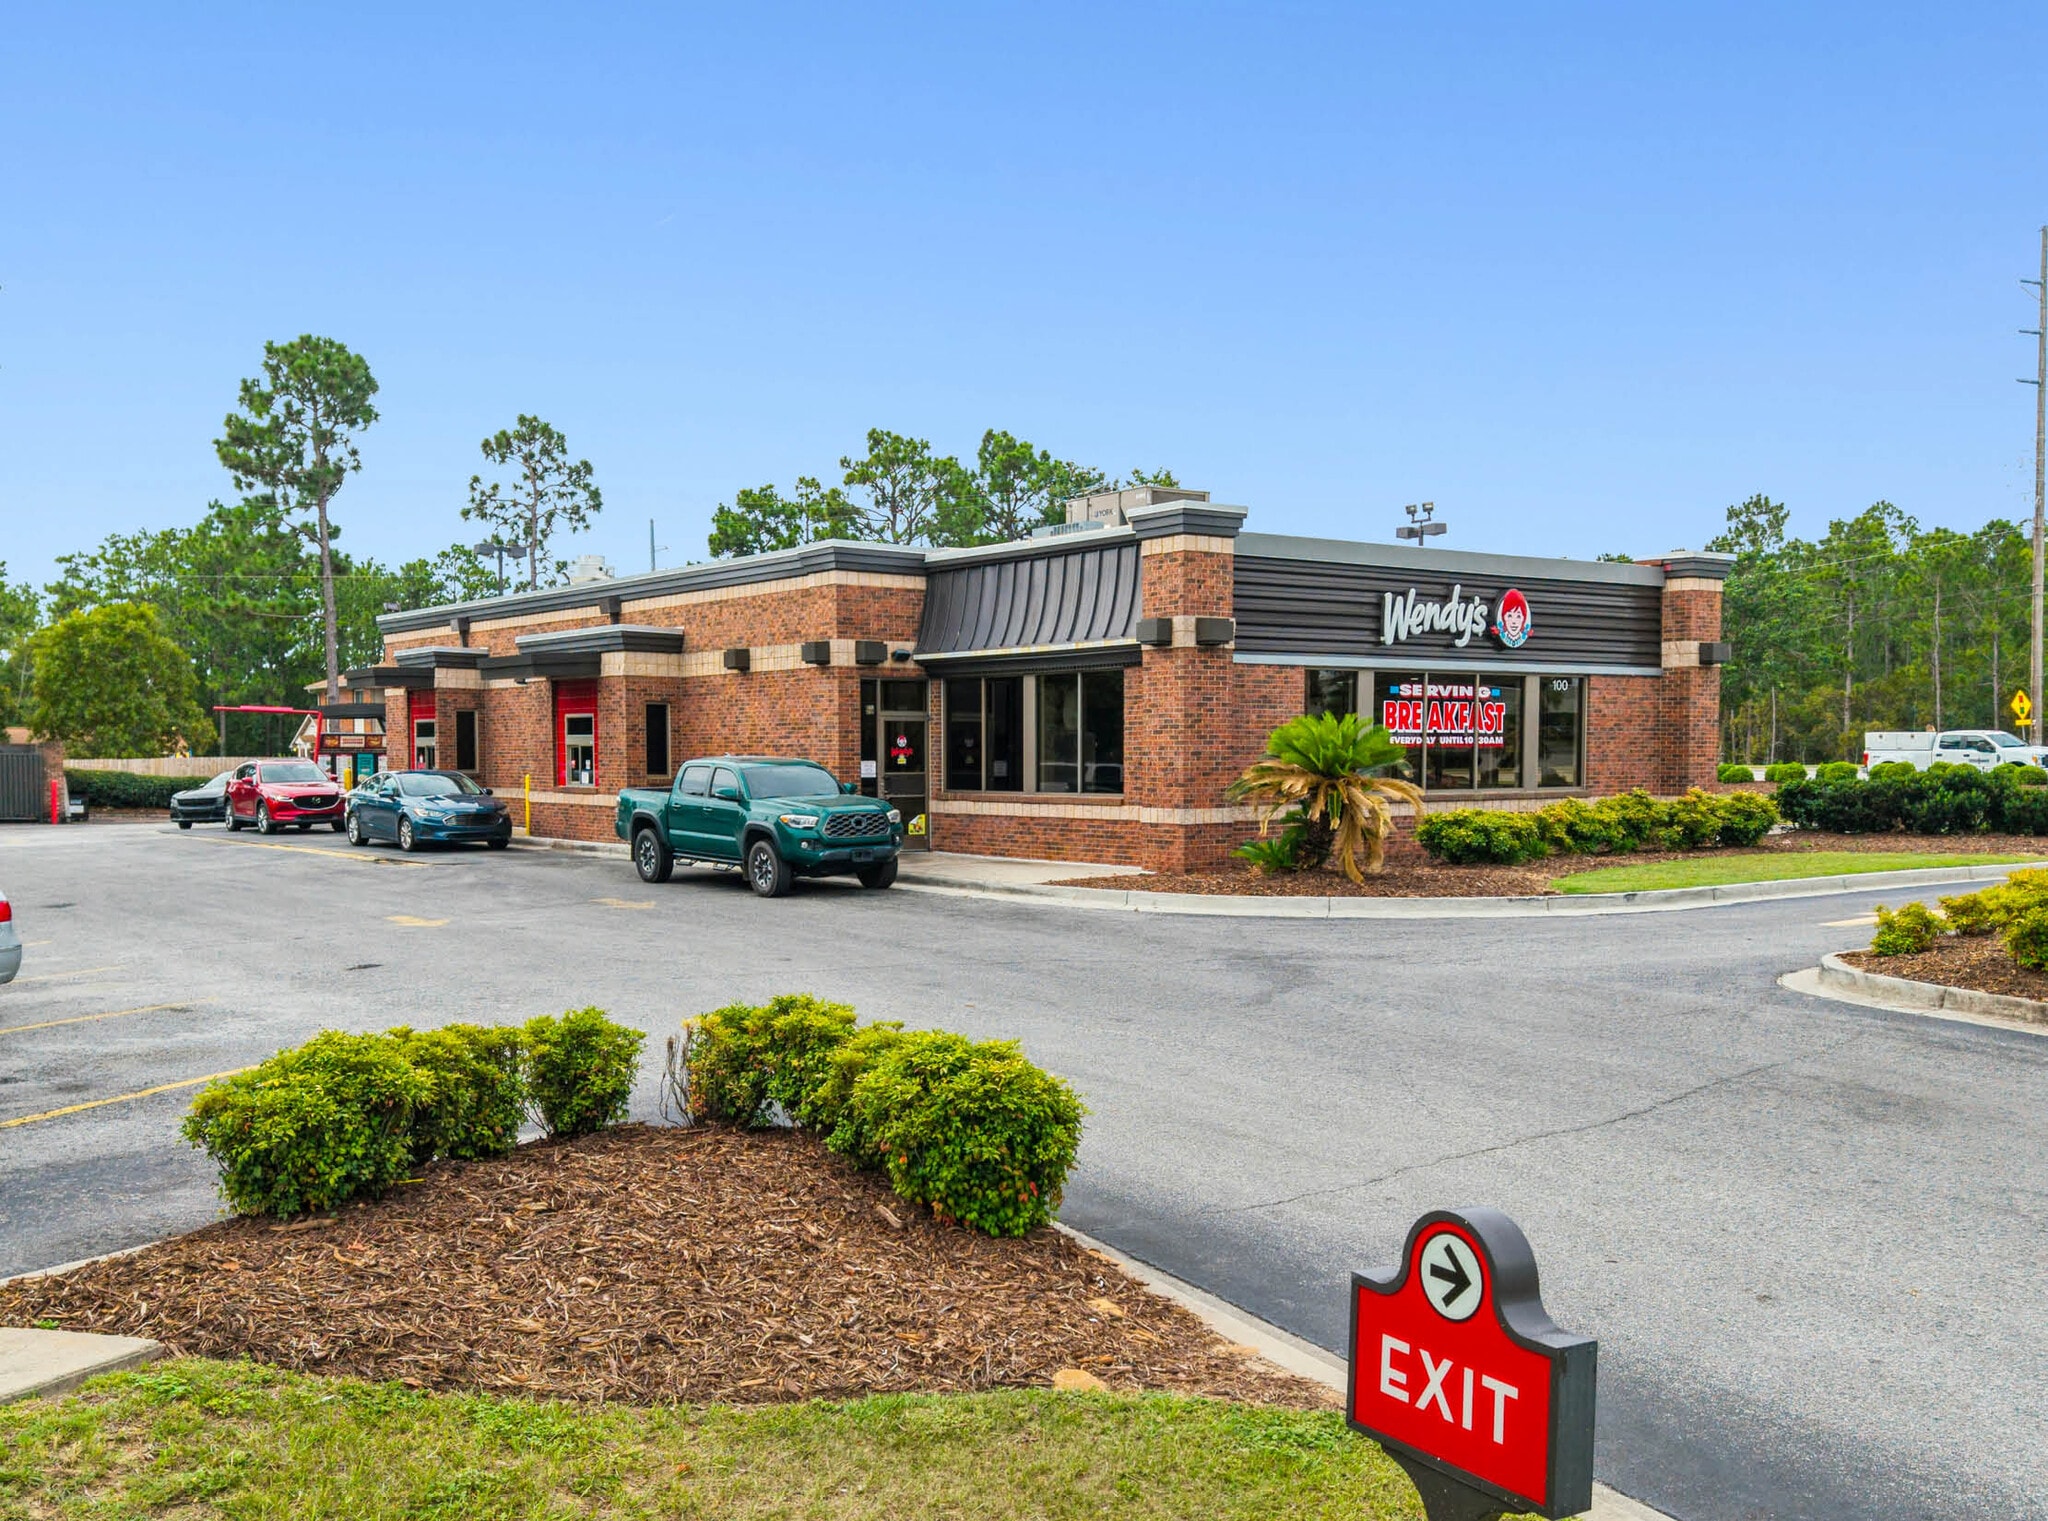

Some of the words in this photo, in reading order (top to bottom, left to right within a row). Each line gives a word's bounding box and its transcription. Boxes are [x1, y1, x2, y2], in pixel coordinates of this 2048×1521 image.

[1384, 584, 1488, 648] Wendy's
[1399, 684, 1492, 698] SERVING
[1553, 679, 1569, 691] 100
[1383, 700, 1505, 733] BREAKFAST
[1389, 736, 1436, 745] EVERYDAY
[1439, 736, 1463, 745] UNTIL
[1464, 736, 1504, 745] 1030AM
[1380, 1333, 1519, 1445] EXIT
